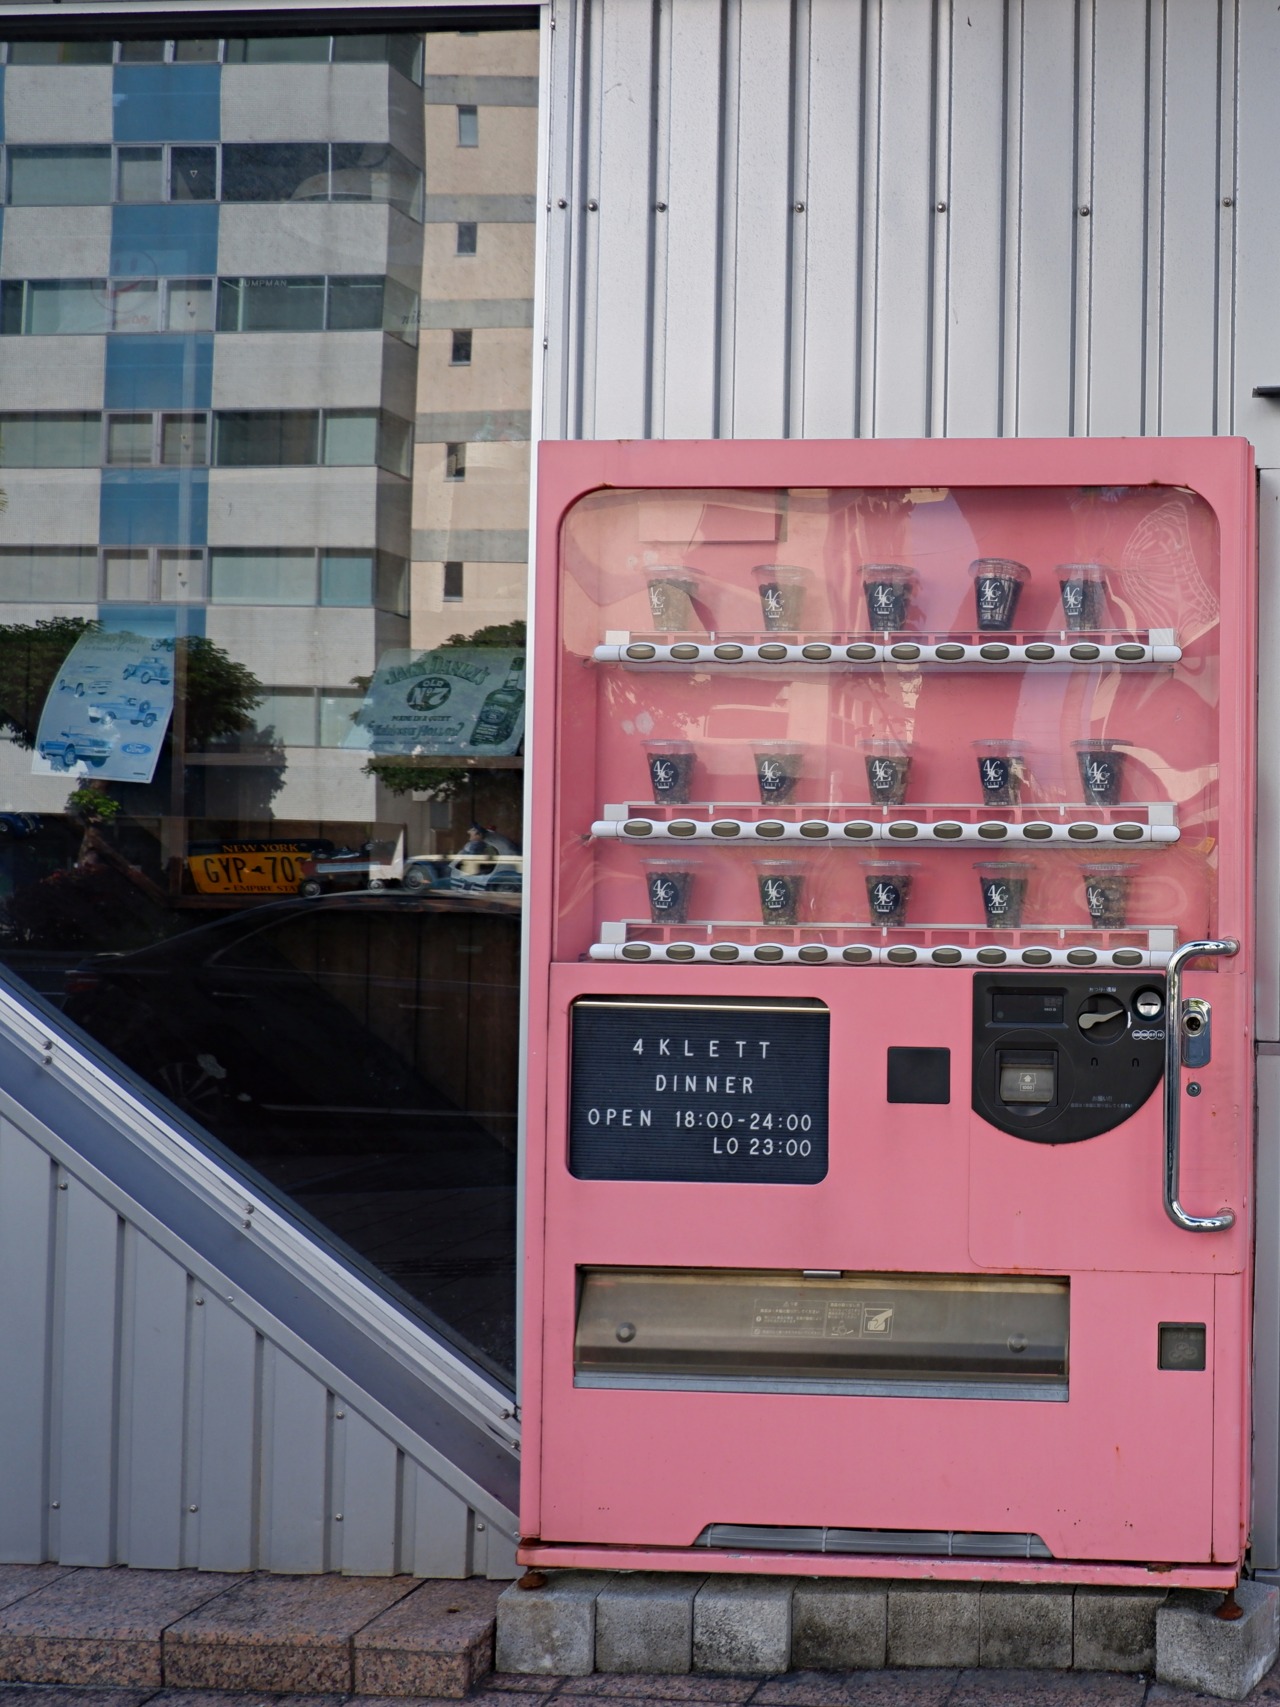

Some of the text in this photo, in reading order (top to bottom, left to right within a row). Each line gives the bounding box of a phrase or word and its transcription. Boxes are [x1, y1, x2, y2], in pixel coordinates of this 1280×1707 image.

[239, 280, 288, 288] JUMPMAN
[222, 843, 299, 853] NEW YORK
[203, 857, 247, 884] GYP
[656, 1074, 753, 1094] DINNER
[588, 1108, 812, 1131] OPEN 18:00-24:00
[713, 1137, 812, 1157] LO 23:00
